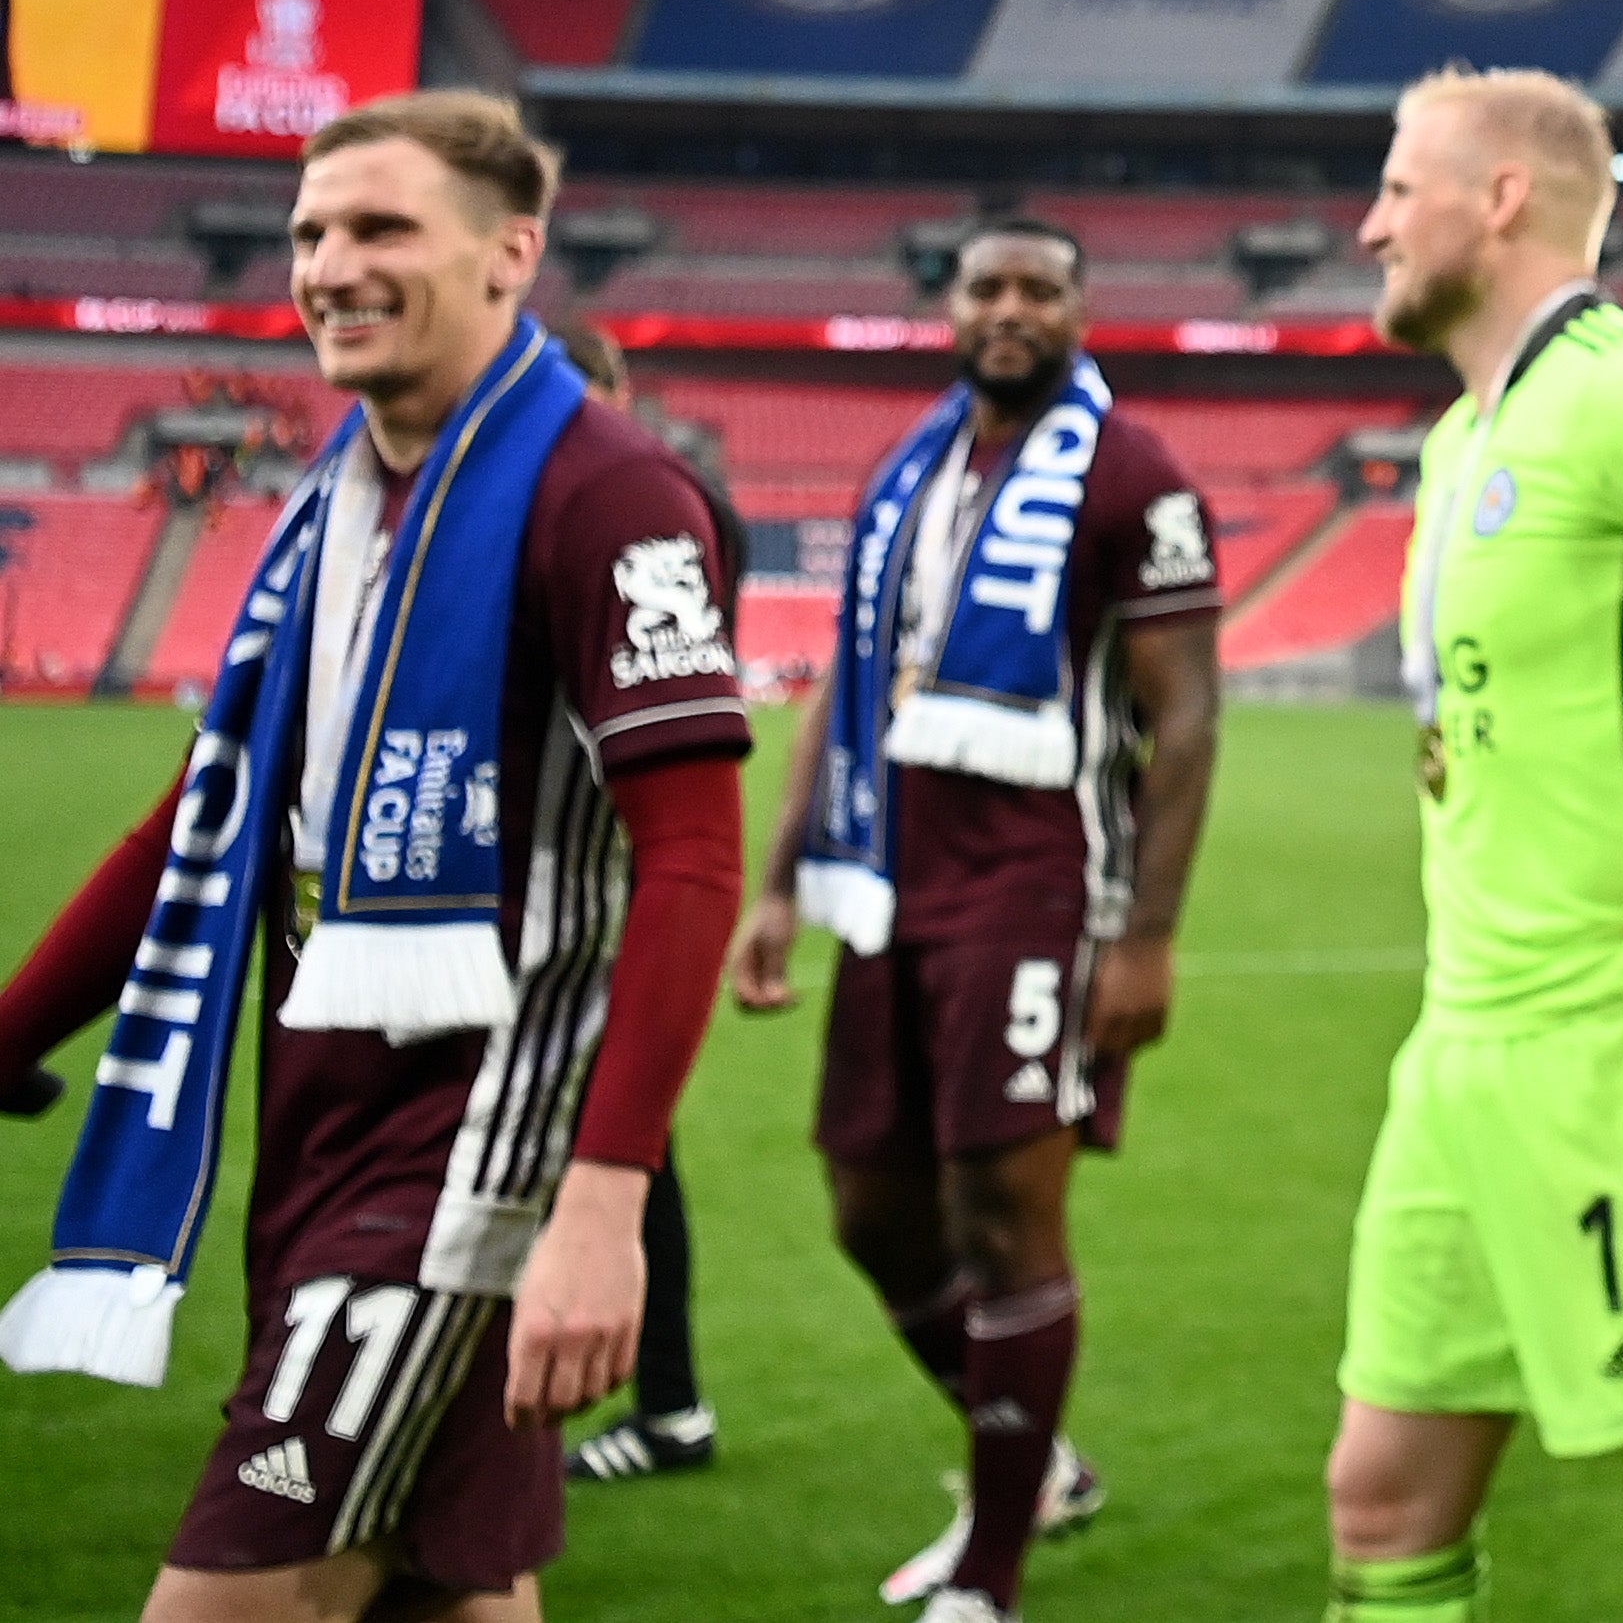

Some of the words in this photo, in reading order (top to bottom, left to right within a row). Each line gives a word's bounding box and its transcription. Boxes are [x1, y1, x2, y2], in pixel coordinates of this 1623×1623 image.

[970, 402, 1100, 637] QUIT
[374, 727, 424, 786] FA
[404, 727, 469, 882] Emirates
[358, 786, 411, 883] CUP
[1002, 957, 1062, 1058] 5
[1579, 1193, 1622, 1314] 1
[262, 1274, 421, 1443] 11
